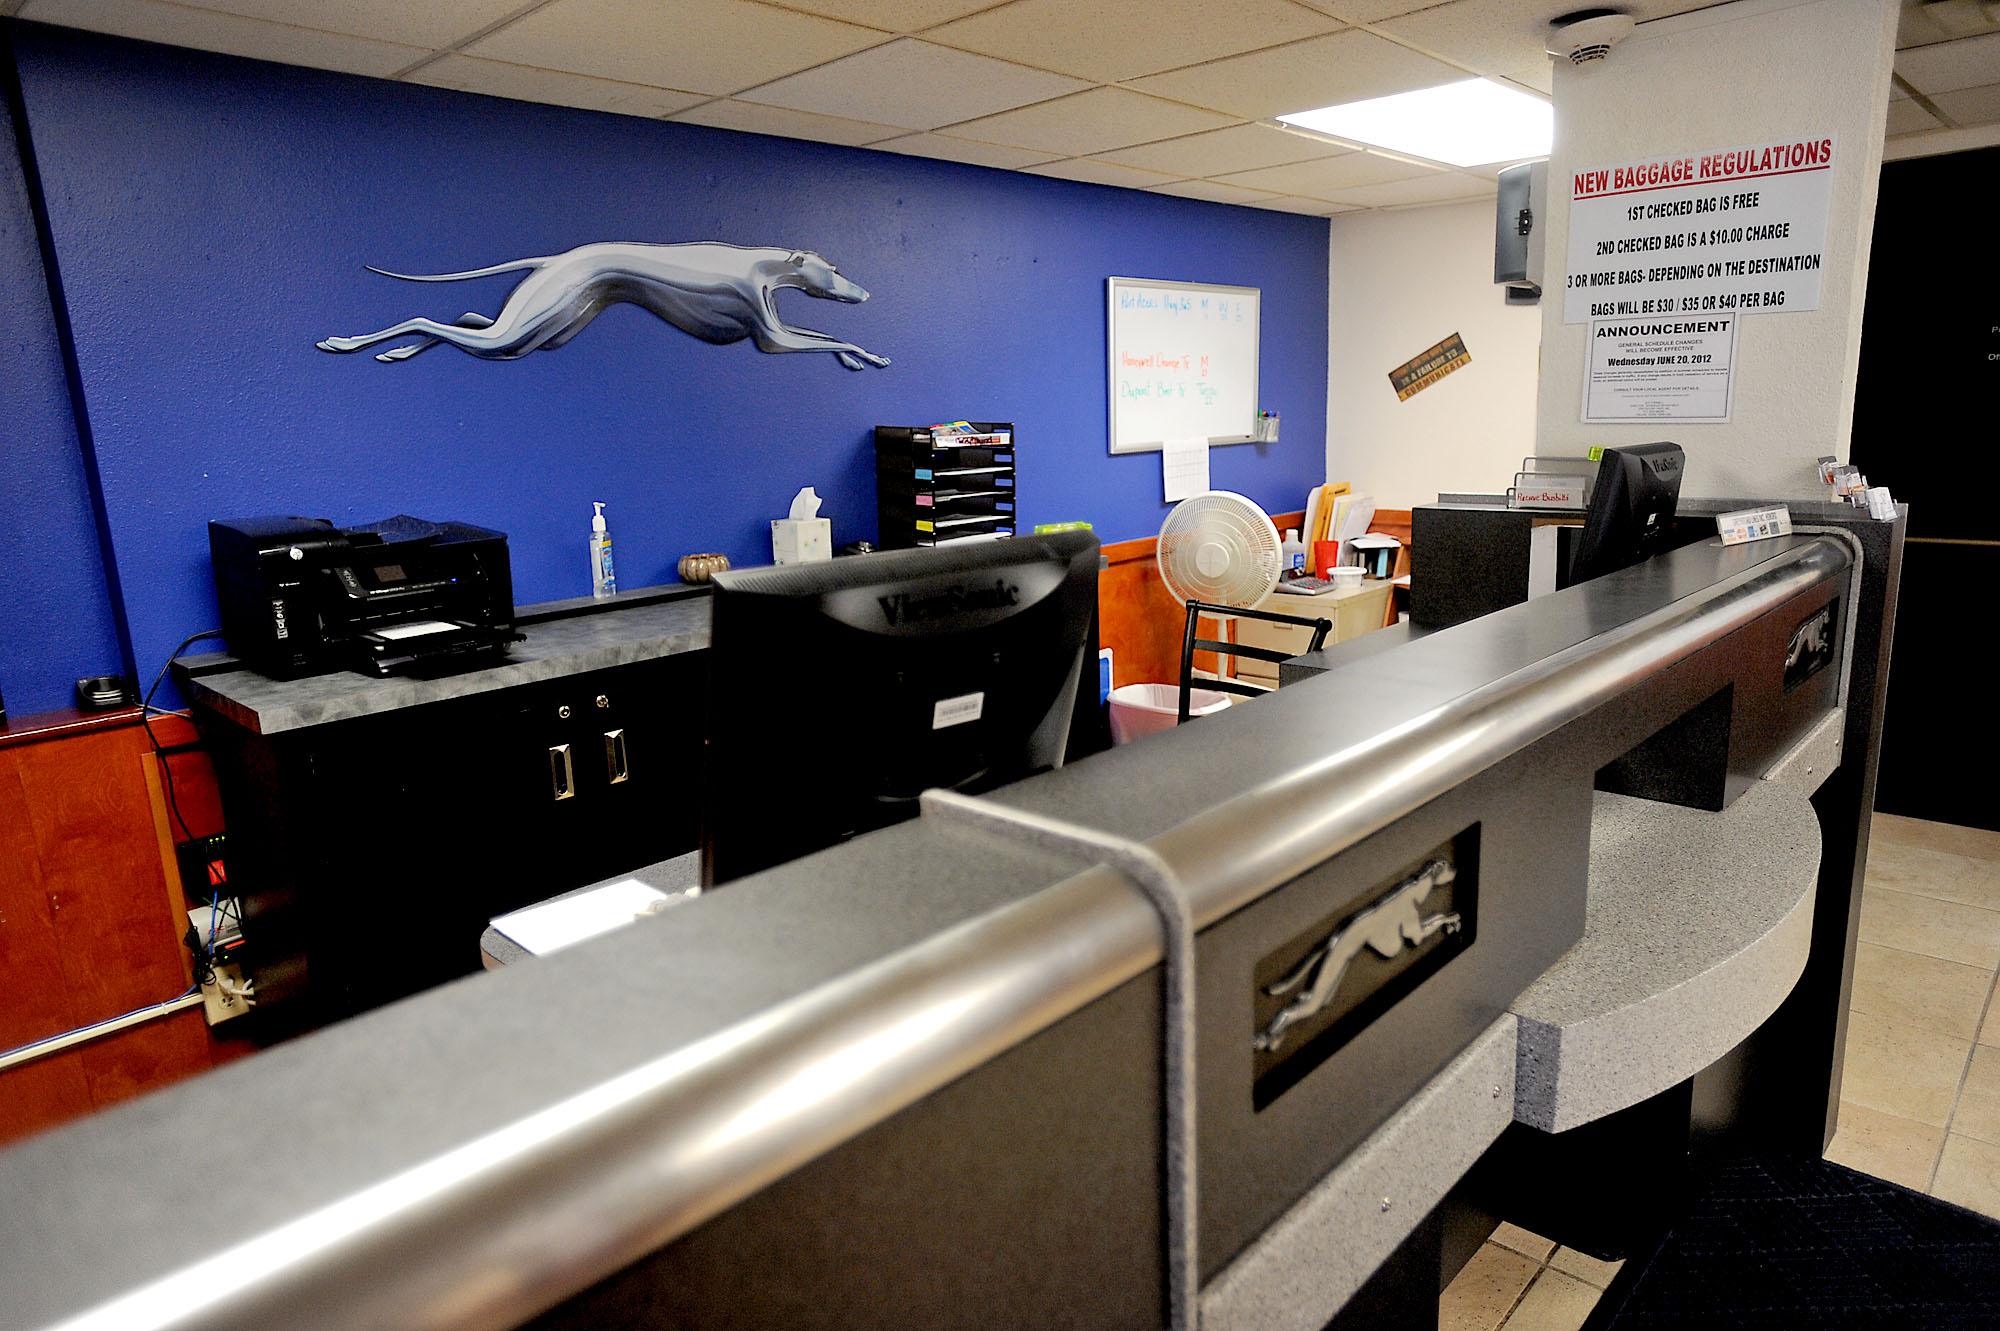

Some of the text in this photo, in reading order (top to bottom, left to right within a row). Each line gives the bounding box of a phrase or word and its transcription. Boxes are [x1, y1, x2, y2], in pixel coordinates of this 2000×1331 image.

[1574, 139, 1832, 194] NEW BAGGAGE REGULATIONS
[1628, 192, 1760, 221] 1ST CHECKED BAG IS FREE
[1597, 223, 1790, 256] 2ND CHECKED BAG IS A $10.00 CHARGE
[1568, 254, 1820, 288] 3 OR MORE BAGS- DEPENDING ON THE DESTINATION
[1591, 290, 1785, 316] BAGS WILL BE $30 / $35 OR $40 PER BAG
[1596, 321, 1730, 338] ANNOUNCEMENT
[1417, 355, 1445, 377] FAILURE
[1608, 355, 1712, 366] Wednesday JUNE 20, 2012
